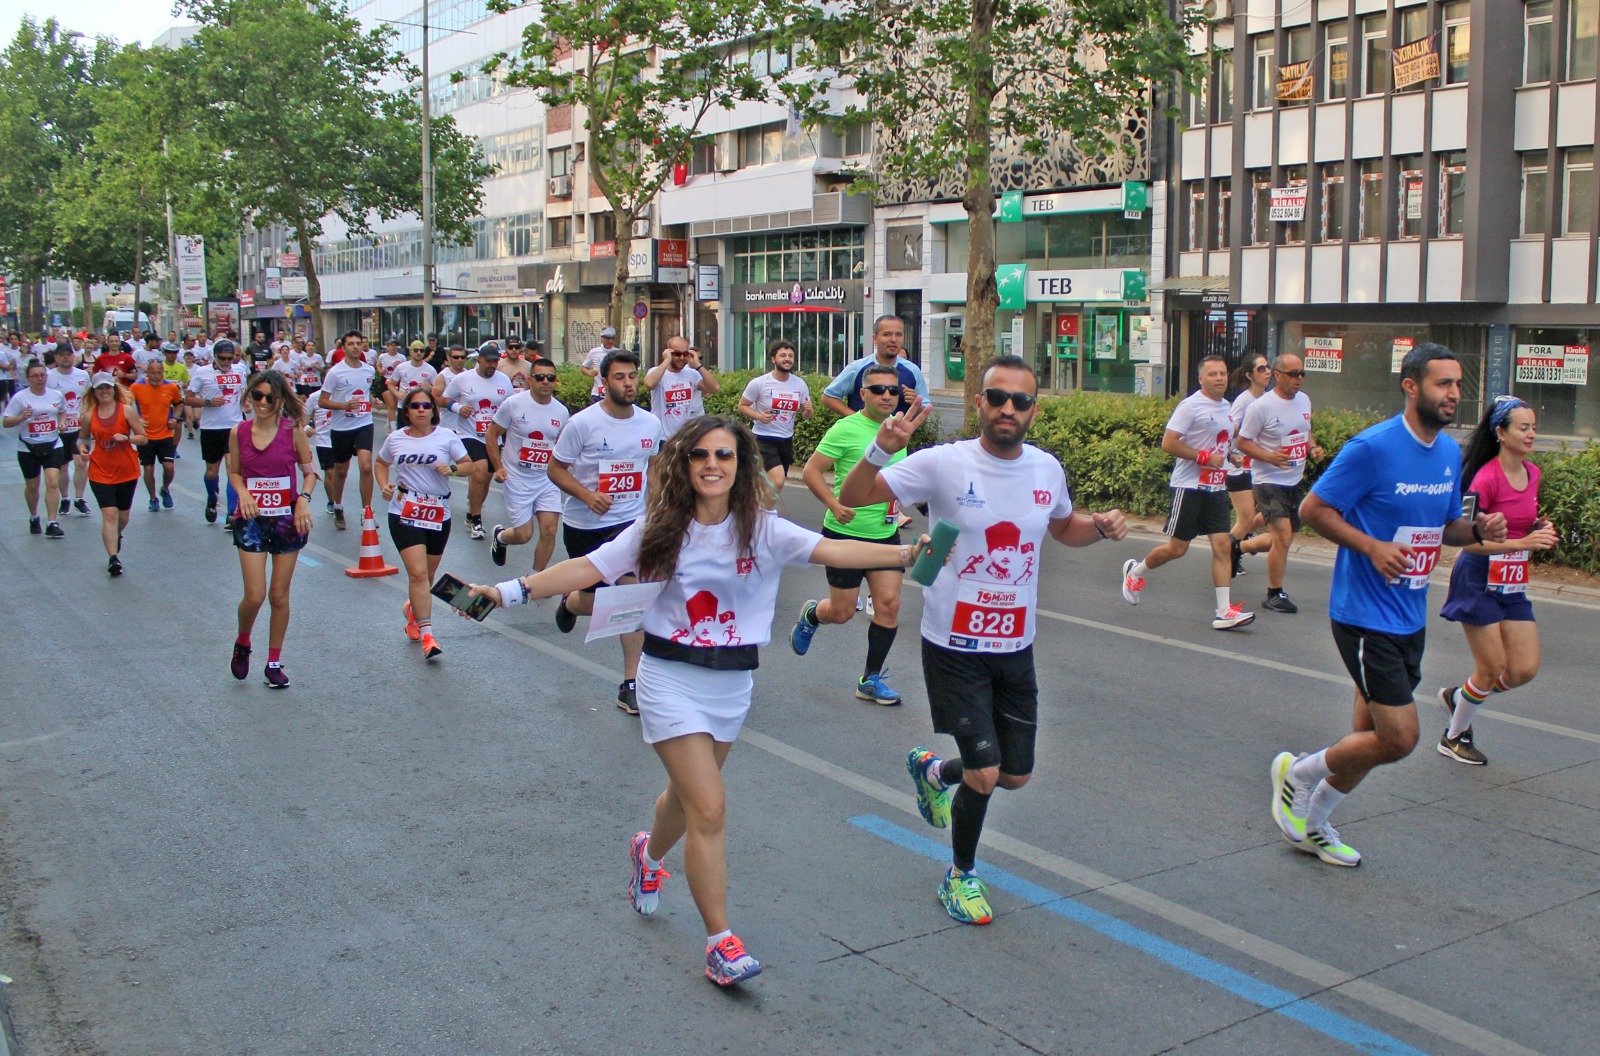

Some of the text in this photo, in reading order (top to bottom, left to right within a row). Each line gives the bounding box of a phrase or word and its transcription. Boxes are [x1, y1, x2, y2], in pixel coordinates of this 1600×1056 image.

[1398, 38, 1429, 62] KİRALIK
[1032, 200, 1054, 211] TEB
[1273, 197, 1304, 207] KİRALIK
[628, 253, 648, 270] spo
[1038, 278, 1072, 295] TEB
[745, 290, 789, 301] bank mellat
[1308, 349, 1339, 358] KİRALIK
[1529, 346, 1552, 355] FORA
[1566, 346, 1587, 354] Kiralık
[1305, 358, 1317, 369] 0535
[1522, 357, 1557, 367] KİRALIK
[1519, 366, 1561, 380] 0535 288 13 31
[222, 375, 238, 384] 369
[671, 391, 687, 401] 483
[777, 400, 794, 410] 475
[34, 423, 52, 432] 902
[527, 450, 548, 462] 279
[1290, 445, 1307, 458] 431
[397, 454, 438, 465] BOLD
[608, 475, 634, 491] 249
[1208, 472, 1224, 483] 152
[252, 493, 282, 506] 789
[411, 506, 437, 520] 310
[1411, 533, 1422, 544] 19
[1500, 564, 1524, 581] 178
[977, 591, 1016, 604] 19 MAYIS
[969, 610, 1015, 635] 828
